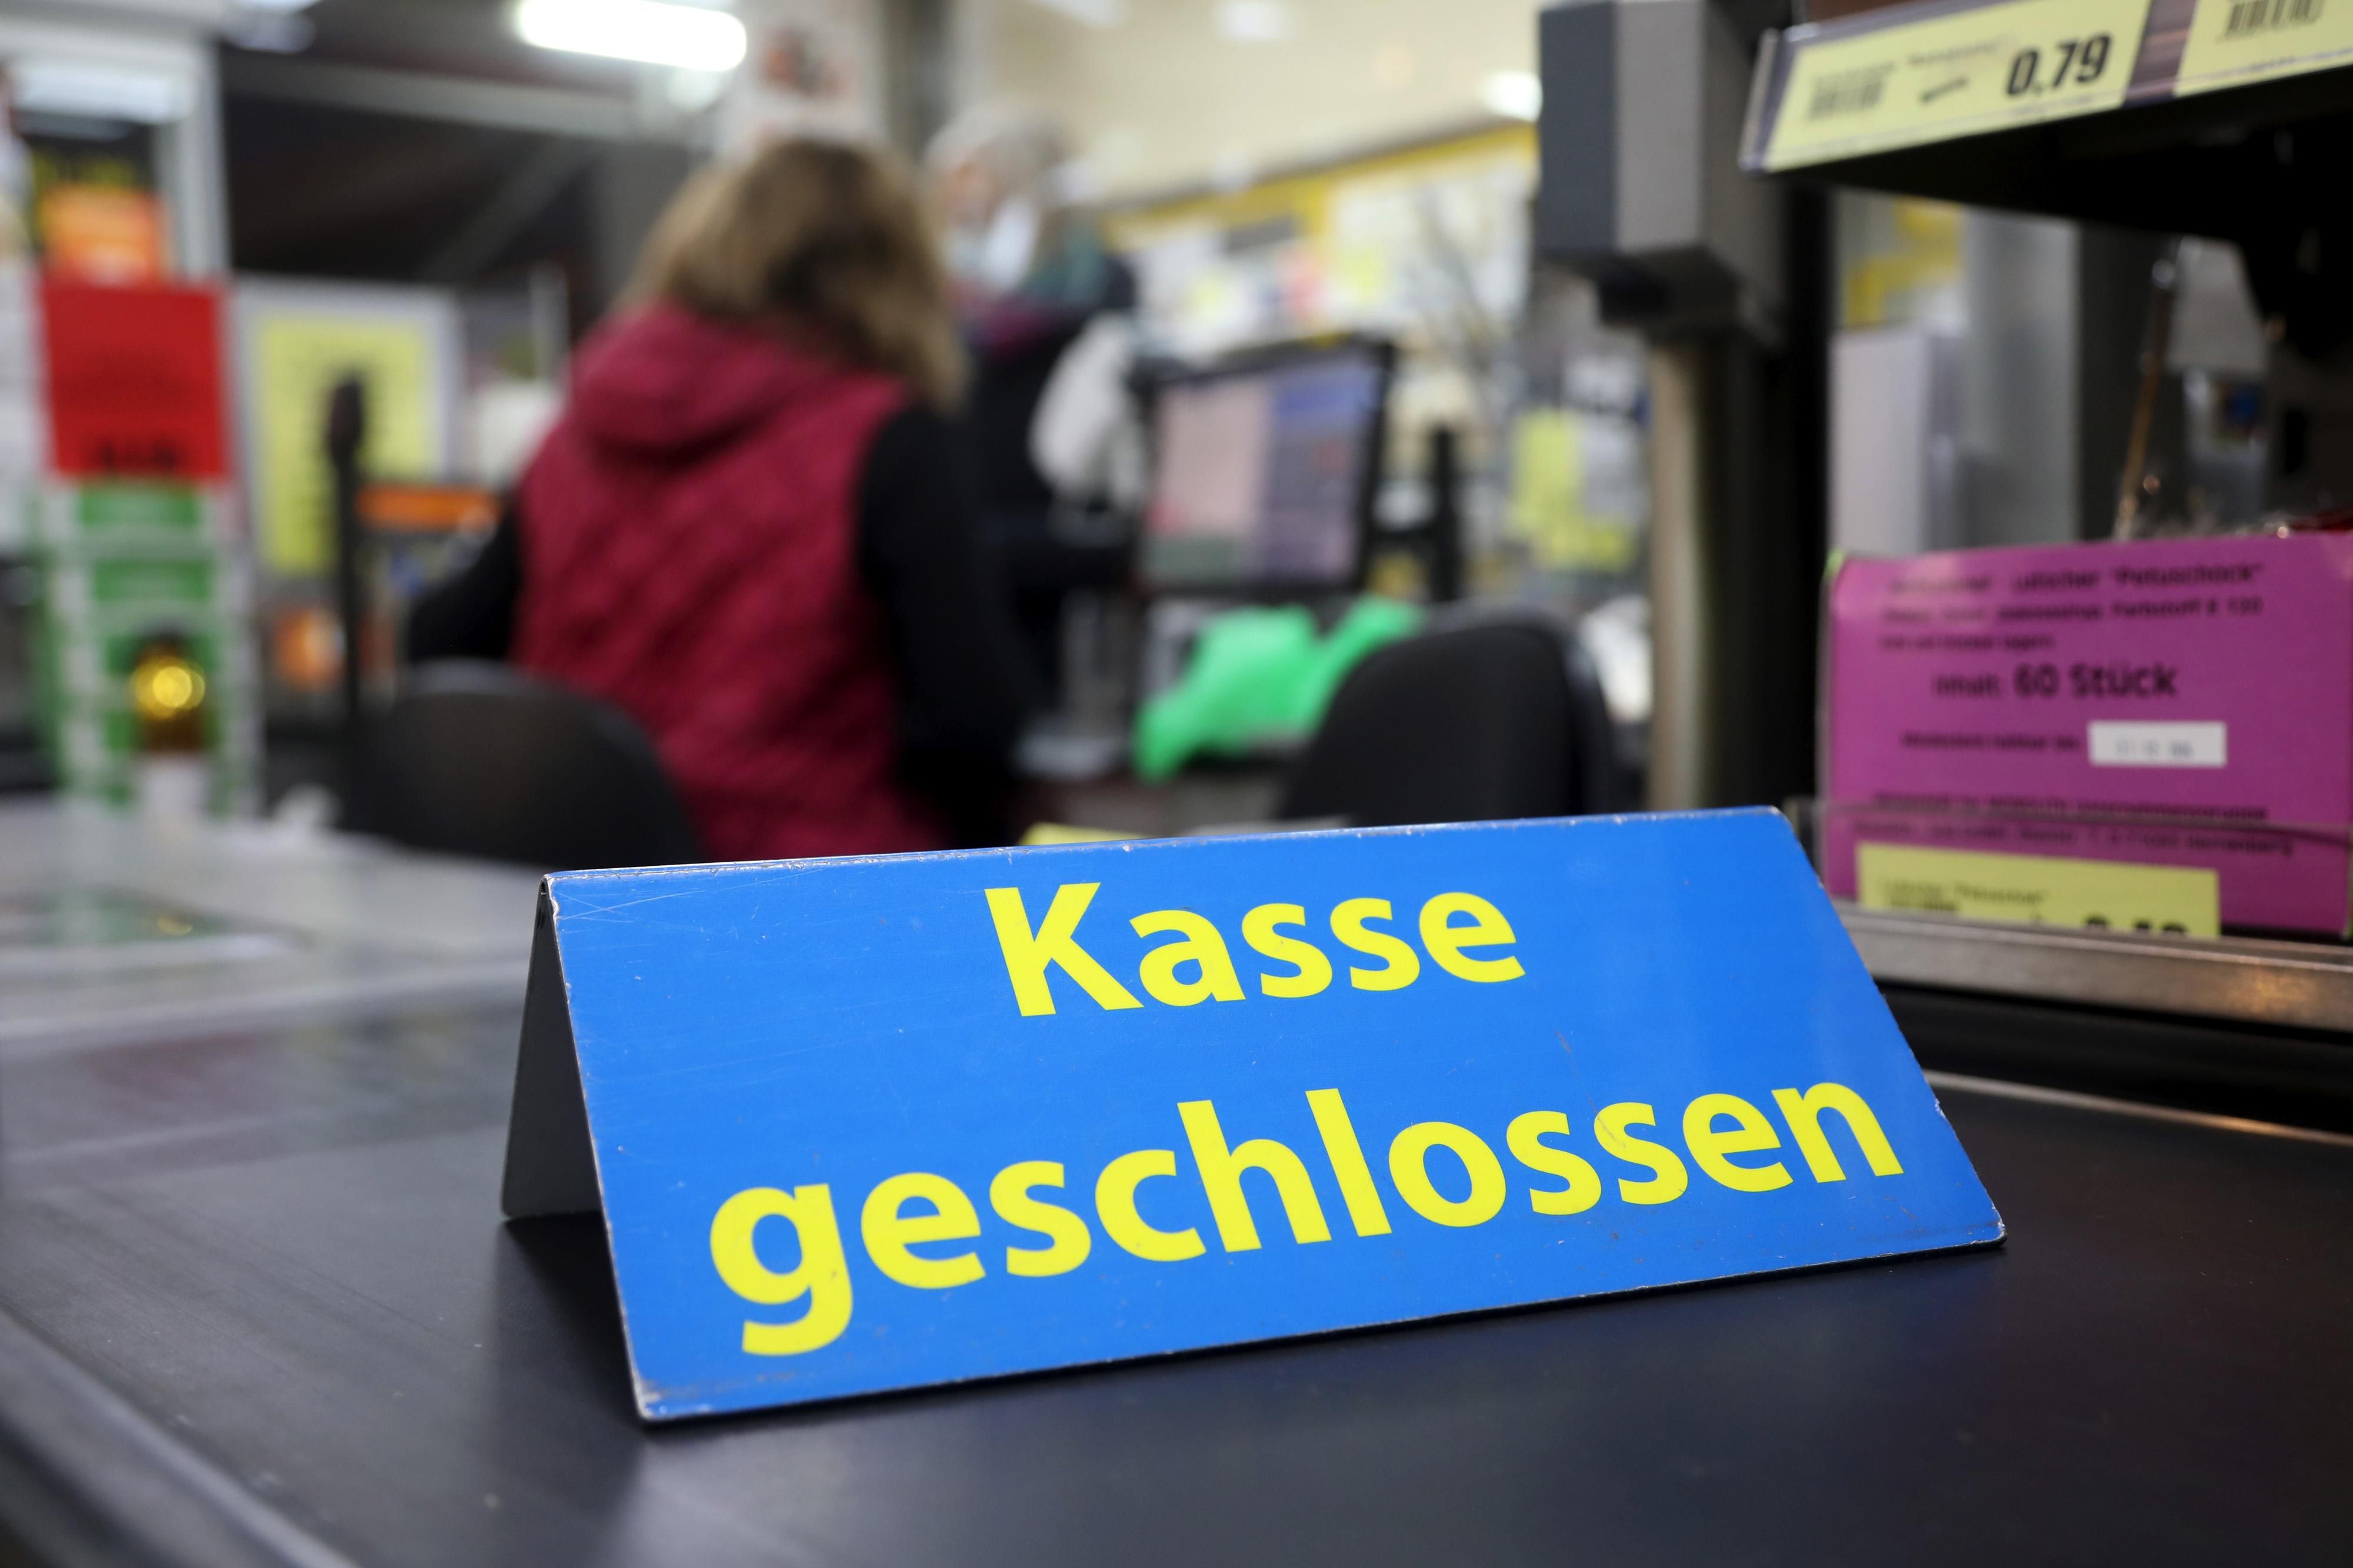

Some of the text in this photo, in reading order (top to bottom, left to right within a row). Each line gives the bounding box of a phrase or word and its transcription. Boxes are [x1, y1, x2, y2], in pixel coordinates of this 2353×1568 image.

[2005, 32, 2112, 98] 0,79
[2012, 662, 2059, 699] 60
[2067, 659, 2181, 699] Stück
[985, 882, 1525, 1017] Kasse
[710, 1082, 1904, 1355] geschlossen
